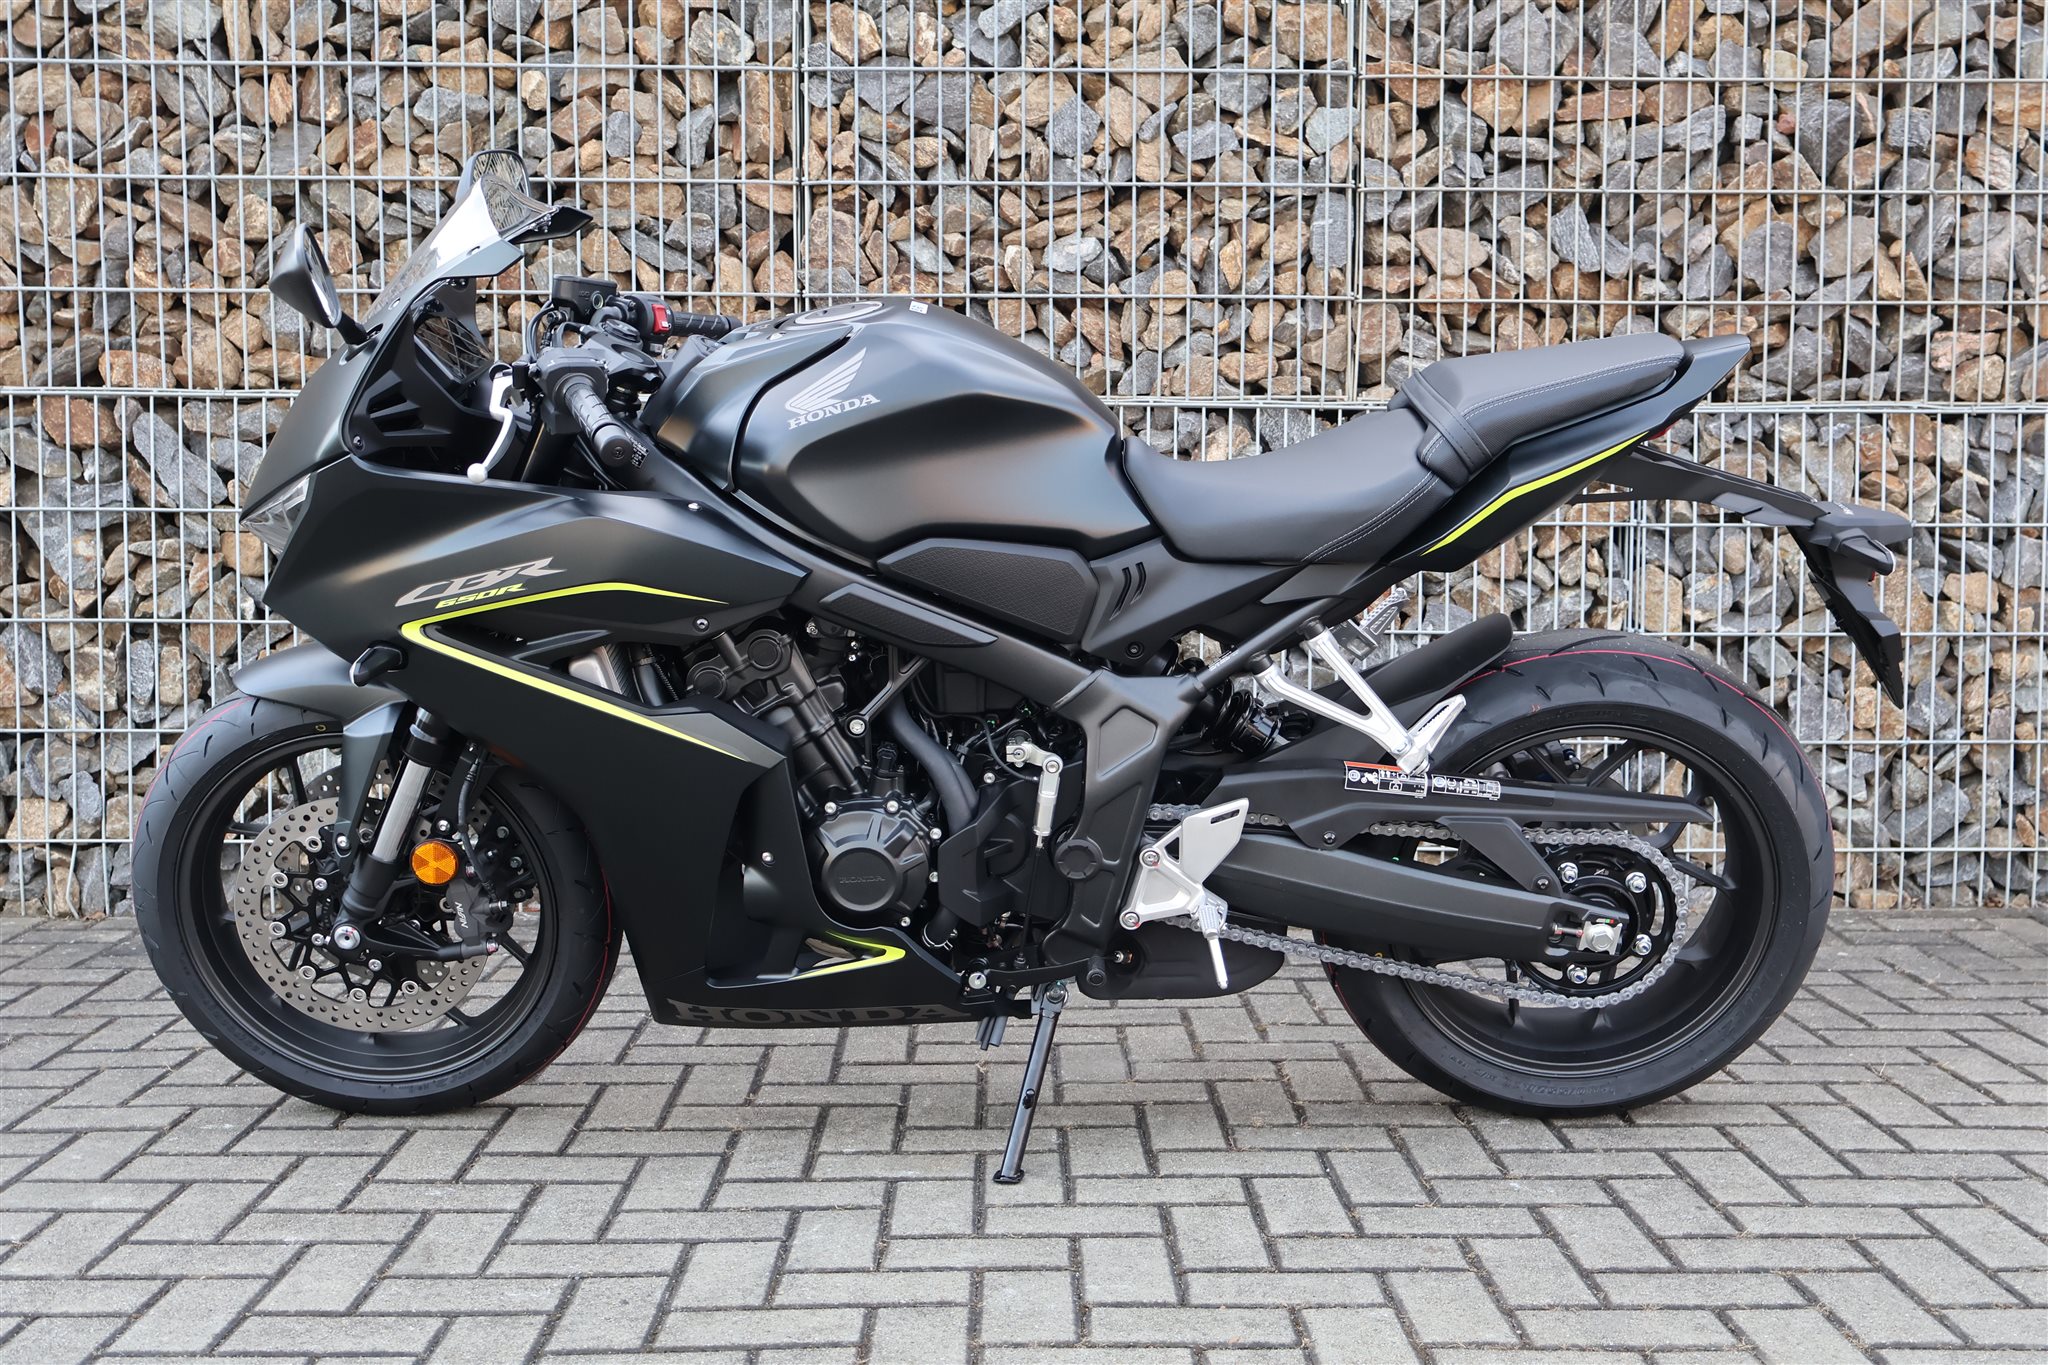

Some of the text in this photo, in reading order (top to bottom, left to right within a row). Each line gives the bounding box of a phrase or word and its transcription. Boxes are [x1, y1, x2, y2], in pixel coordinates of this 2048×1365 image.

[787, 394, 880, 430] HONDA
[394, 556, 568, 607] CBR
[435, 583, 528, 609] 650R
[838, 875, 887, 885] HONDA
[666, 998, 973, 1024] HONDA
